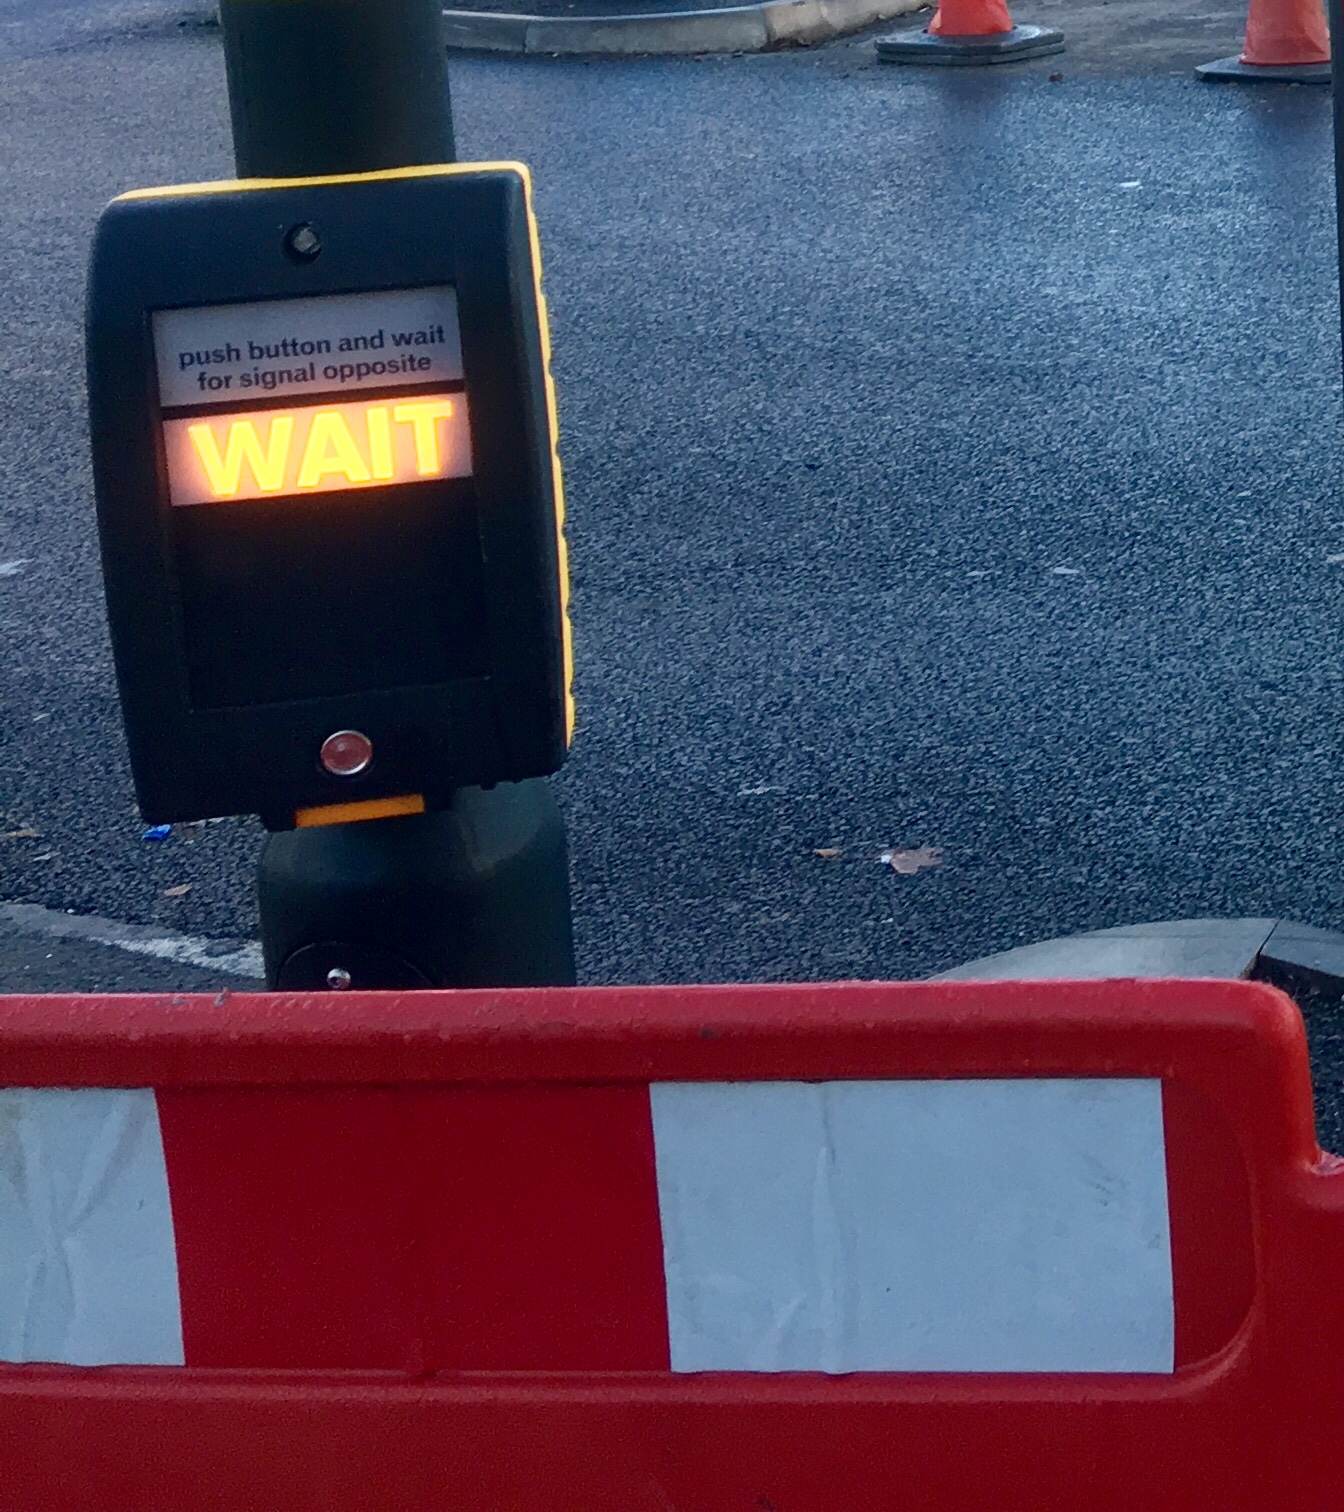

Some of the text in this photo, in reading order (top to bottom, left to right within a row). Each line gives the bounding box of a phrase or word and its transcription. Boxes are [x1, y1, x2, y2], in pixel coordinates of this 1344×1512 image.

[179, 324, 446, 370] push button and wait
[197, 353, 432, 391] for signal opposite
[188, 398, 453, 497] WAIT
